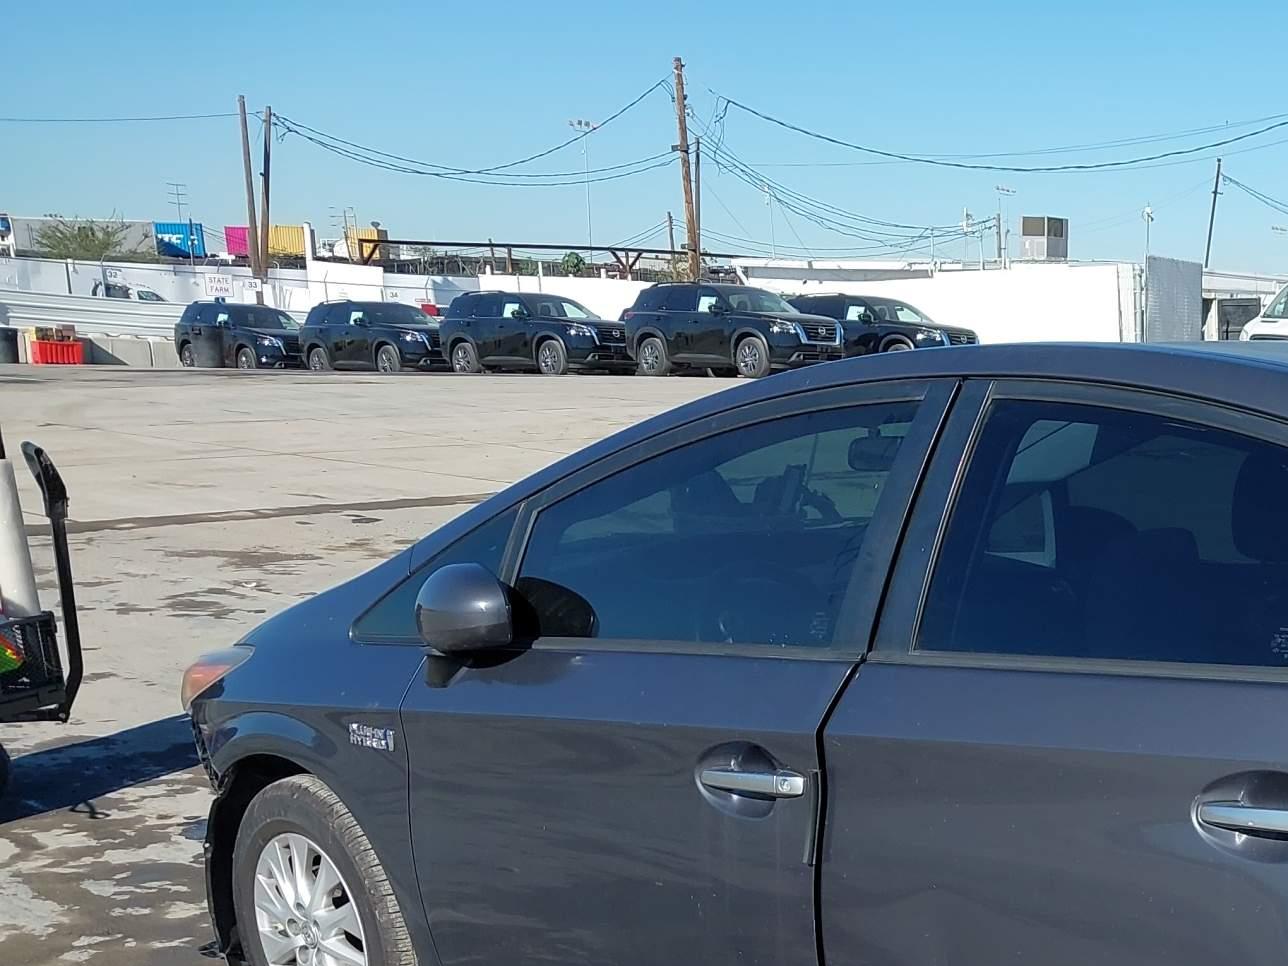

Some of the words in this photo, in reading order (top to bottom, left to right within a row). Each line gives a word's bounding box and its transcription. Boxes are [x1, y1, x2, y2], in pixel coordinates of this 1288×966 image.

[107, 271, 118, 279] 32
[208, 277, 230, 285] STATE
[248, 281, 258, 289] 33
[210, 285, 230, 293] FARM
